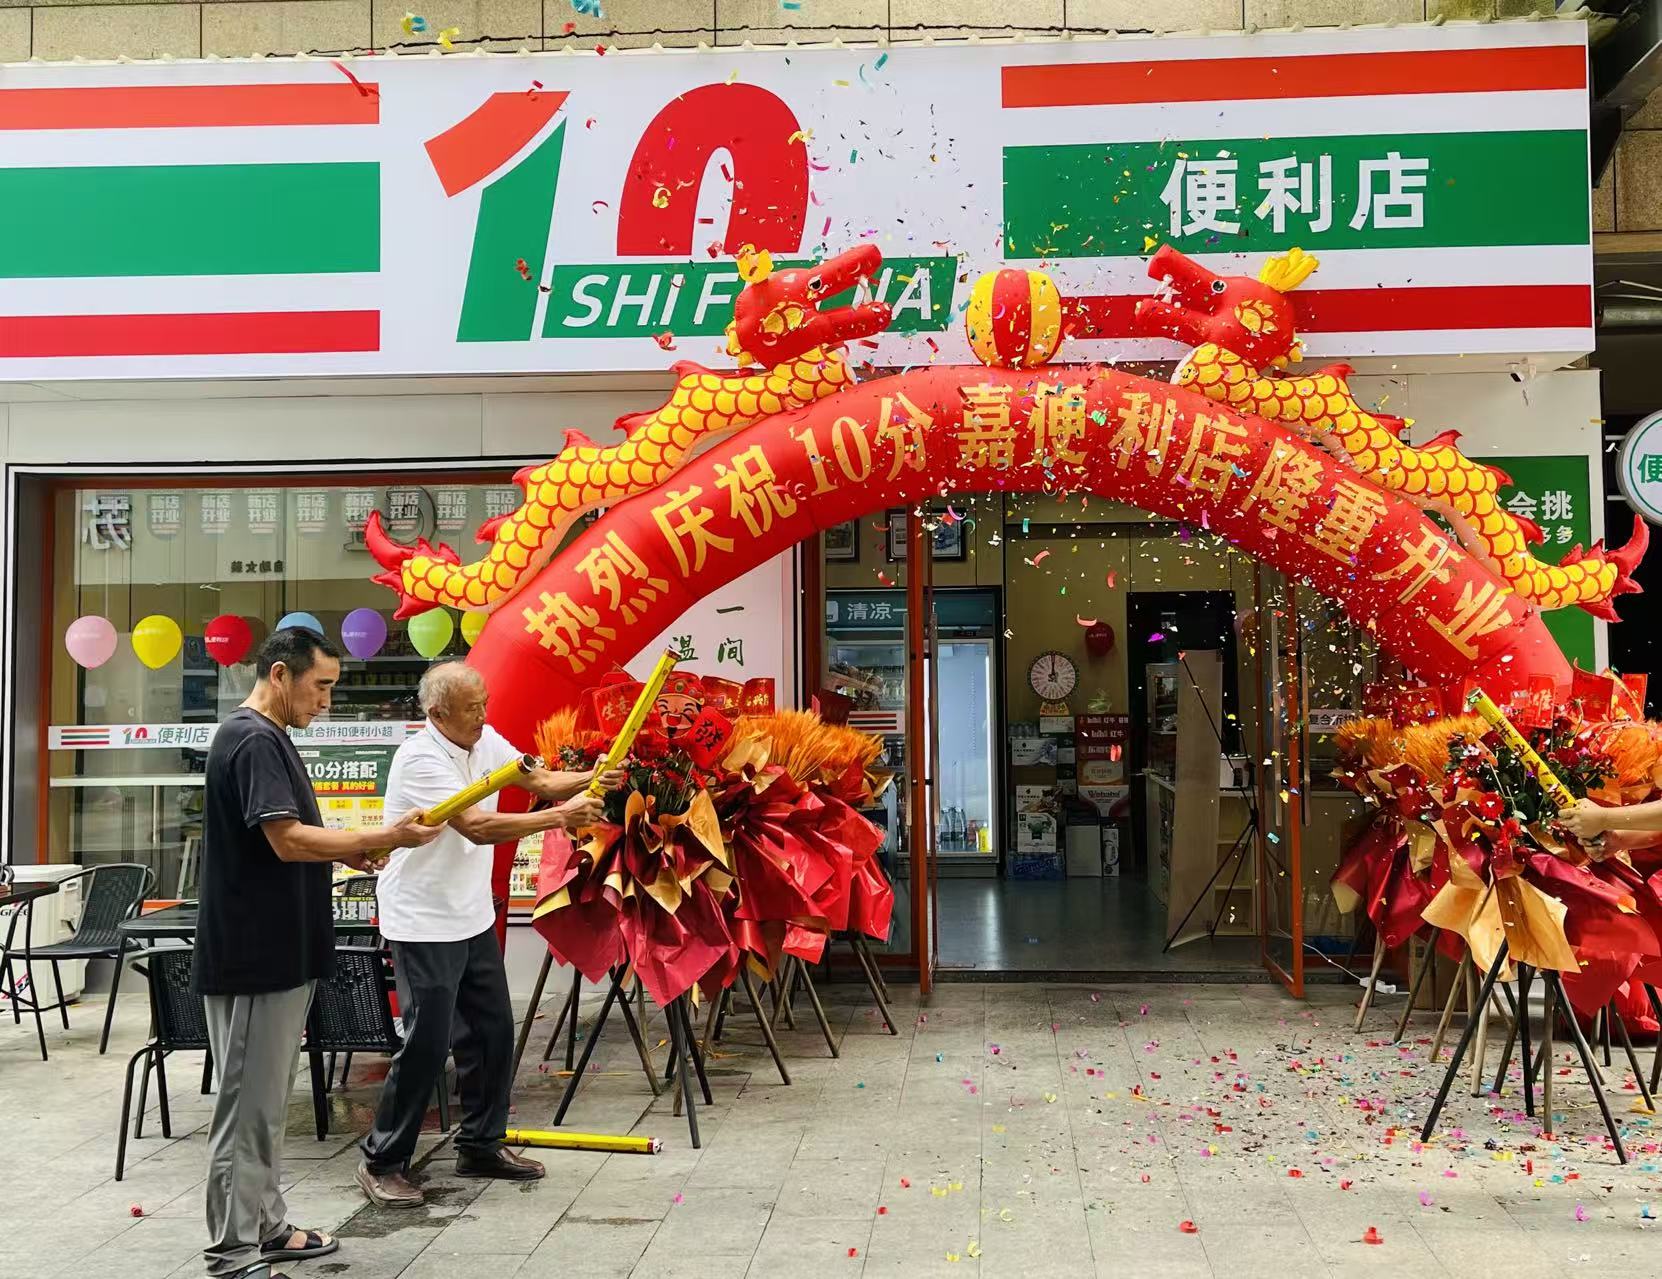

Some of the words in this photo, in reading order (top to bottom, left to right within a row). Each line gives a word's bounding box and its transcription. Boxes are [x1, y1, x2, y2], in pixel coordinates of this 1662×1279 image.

[424, 82, 810, 342] 10
[1160, 151, 1430, 236] 便利店
[562, 273, 684, 327] SHI
[1637, 453, 1662, 483] 便
[1498, 490, 1574, 521] 会挑
[522, 383, 1512, 674] 热烈庆祝10分嘉便利店隆重开业
[158, 727, 210, 744] 便利店
[305, 761, 378, 779] 10分搭配
